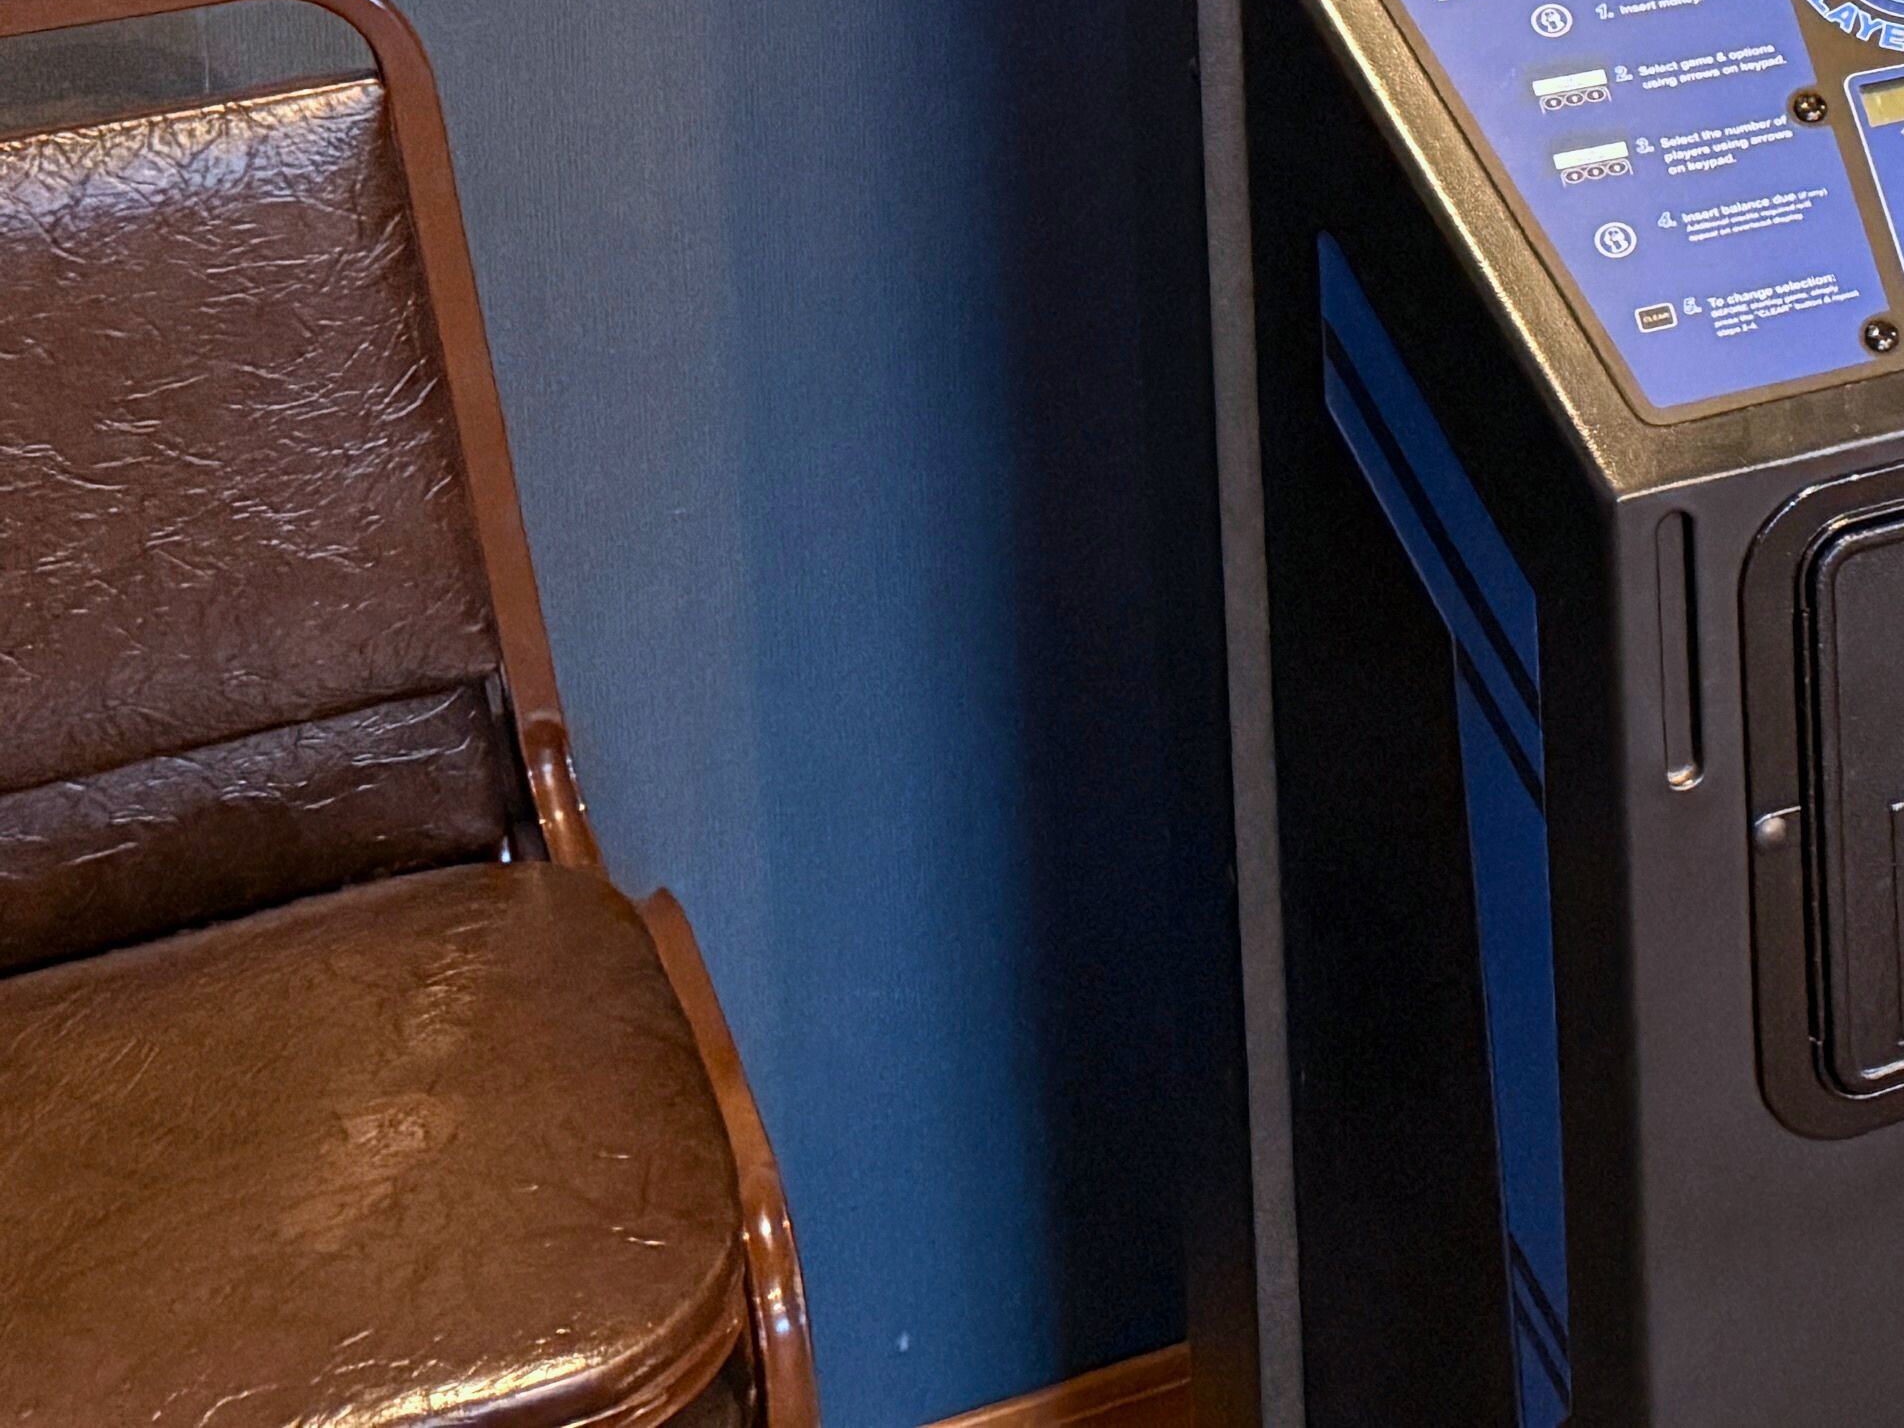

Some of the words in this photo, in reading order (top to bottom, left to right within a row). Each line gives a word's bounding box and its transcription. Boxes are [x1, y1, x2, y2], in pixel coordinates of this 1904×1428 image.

[1620, 1, 1655, 15] Insert
[1638, 61, 1678, 76] Select
[1680, 55, 1713, 71] game
[1716, 52, 1726, 62] &
[1728, 44, 1775, 60] options
[1643, 76, 1678, 89] using
[1680, 68, 1720, 83] arrows
[1722, 64, 1738, 74] on
[1740, 55, 1787, 72] keypad.
[1660, 132, 1700, 148] Select
[1701, 129, 1722, 141] the
[1724, 119, 1771, 136] number
[1774, 115, 1787, 126] of
[1664, 145, 1711, 163] players
[1713, 138, 1749, 153] using
[1751, 130, 1793, 145] arrows
[1668, 164, 1685, 175] on
[1682, 208, 1719, 223] Insert
[1721, 198, 1770, 215] balance
[1772, 193, 1796, 204] due
[1707, 297, 1725, 308] To
[1727, 288, 1773, 304] change
[1776, 274, 1836, 293] selection:
